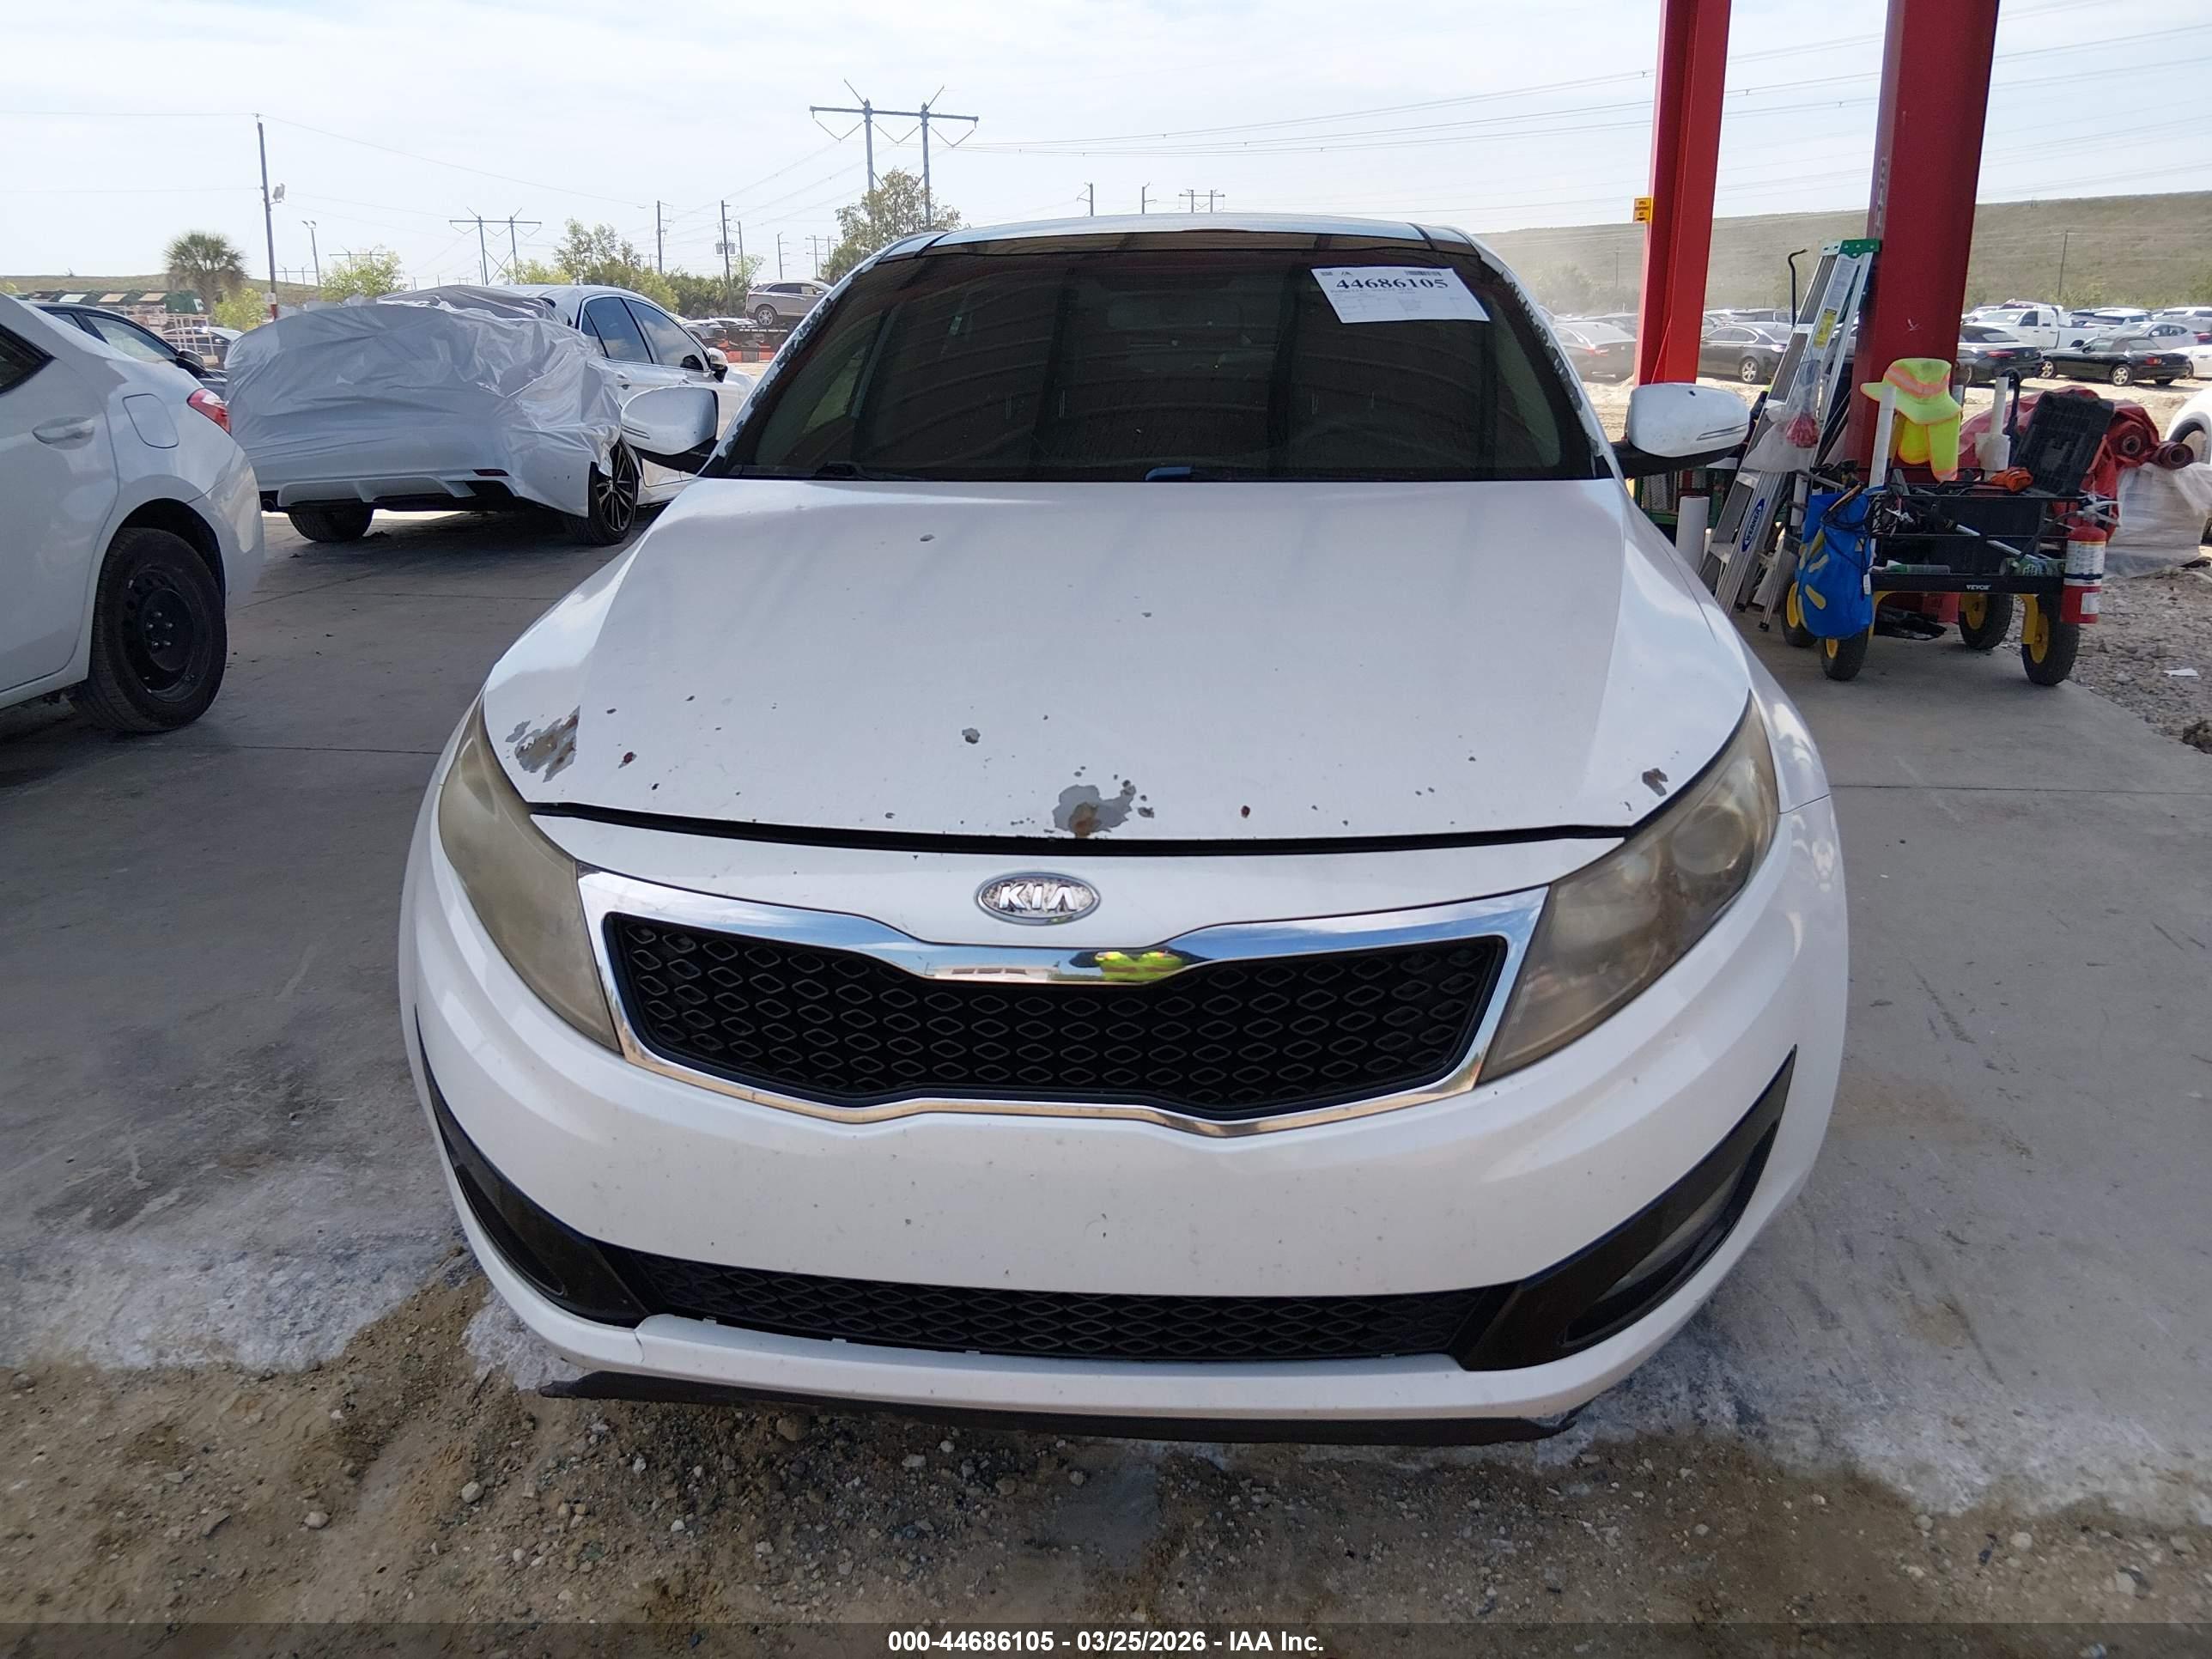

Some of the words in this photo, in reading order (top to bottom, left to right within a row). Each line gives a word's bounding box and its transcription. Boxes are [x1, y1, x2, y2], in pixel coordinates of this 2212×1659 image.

[1335, 277, 1449, 290] 44686105
[1744, 505, 1762, 545] WERNER
[998, 884, 1077, 911] KIA
